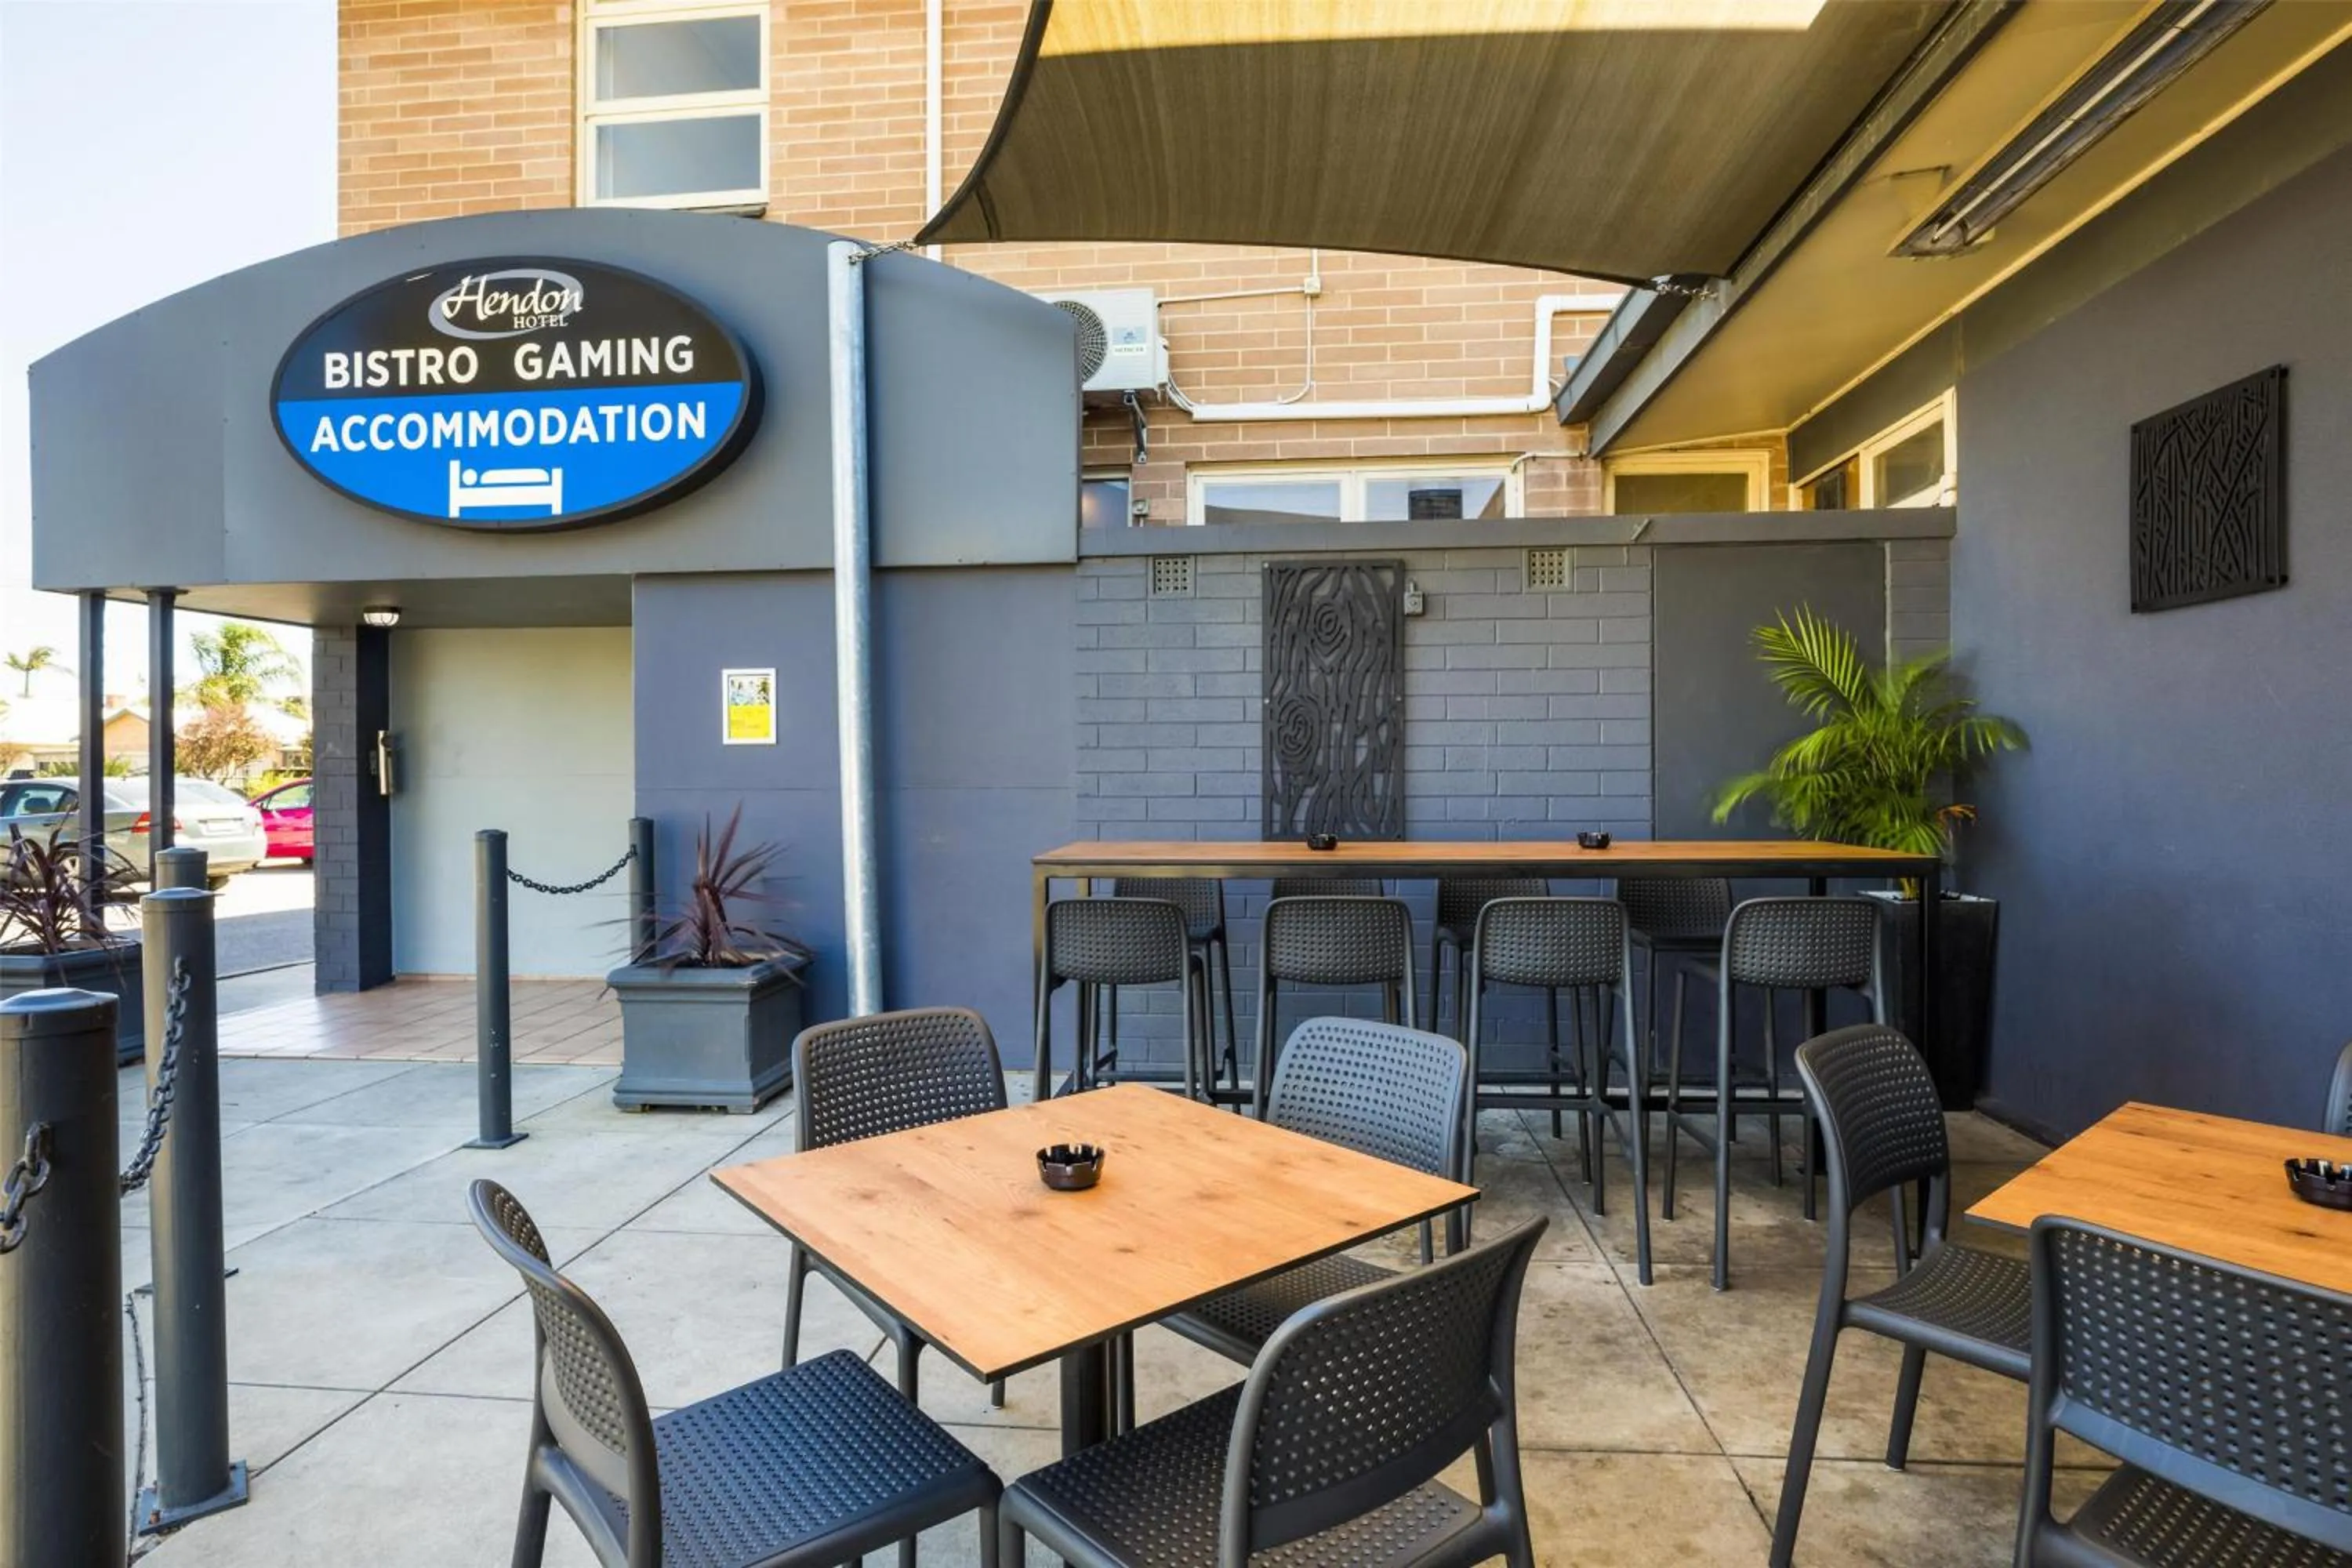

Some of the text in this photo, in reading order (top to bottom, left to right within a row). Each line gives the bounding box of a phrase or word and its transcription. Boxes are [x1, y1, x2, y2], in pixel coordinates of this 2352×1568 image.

[441, 274, 583, 321] Hendon
[514, 314, 568, 329] HOTEL
[324, 335, 695, 390] BISTRO GAMING
[310, 401, 706, 453] ACCOMMODATION
